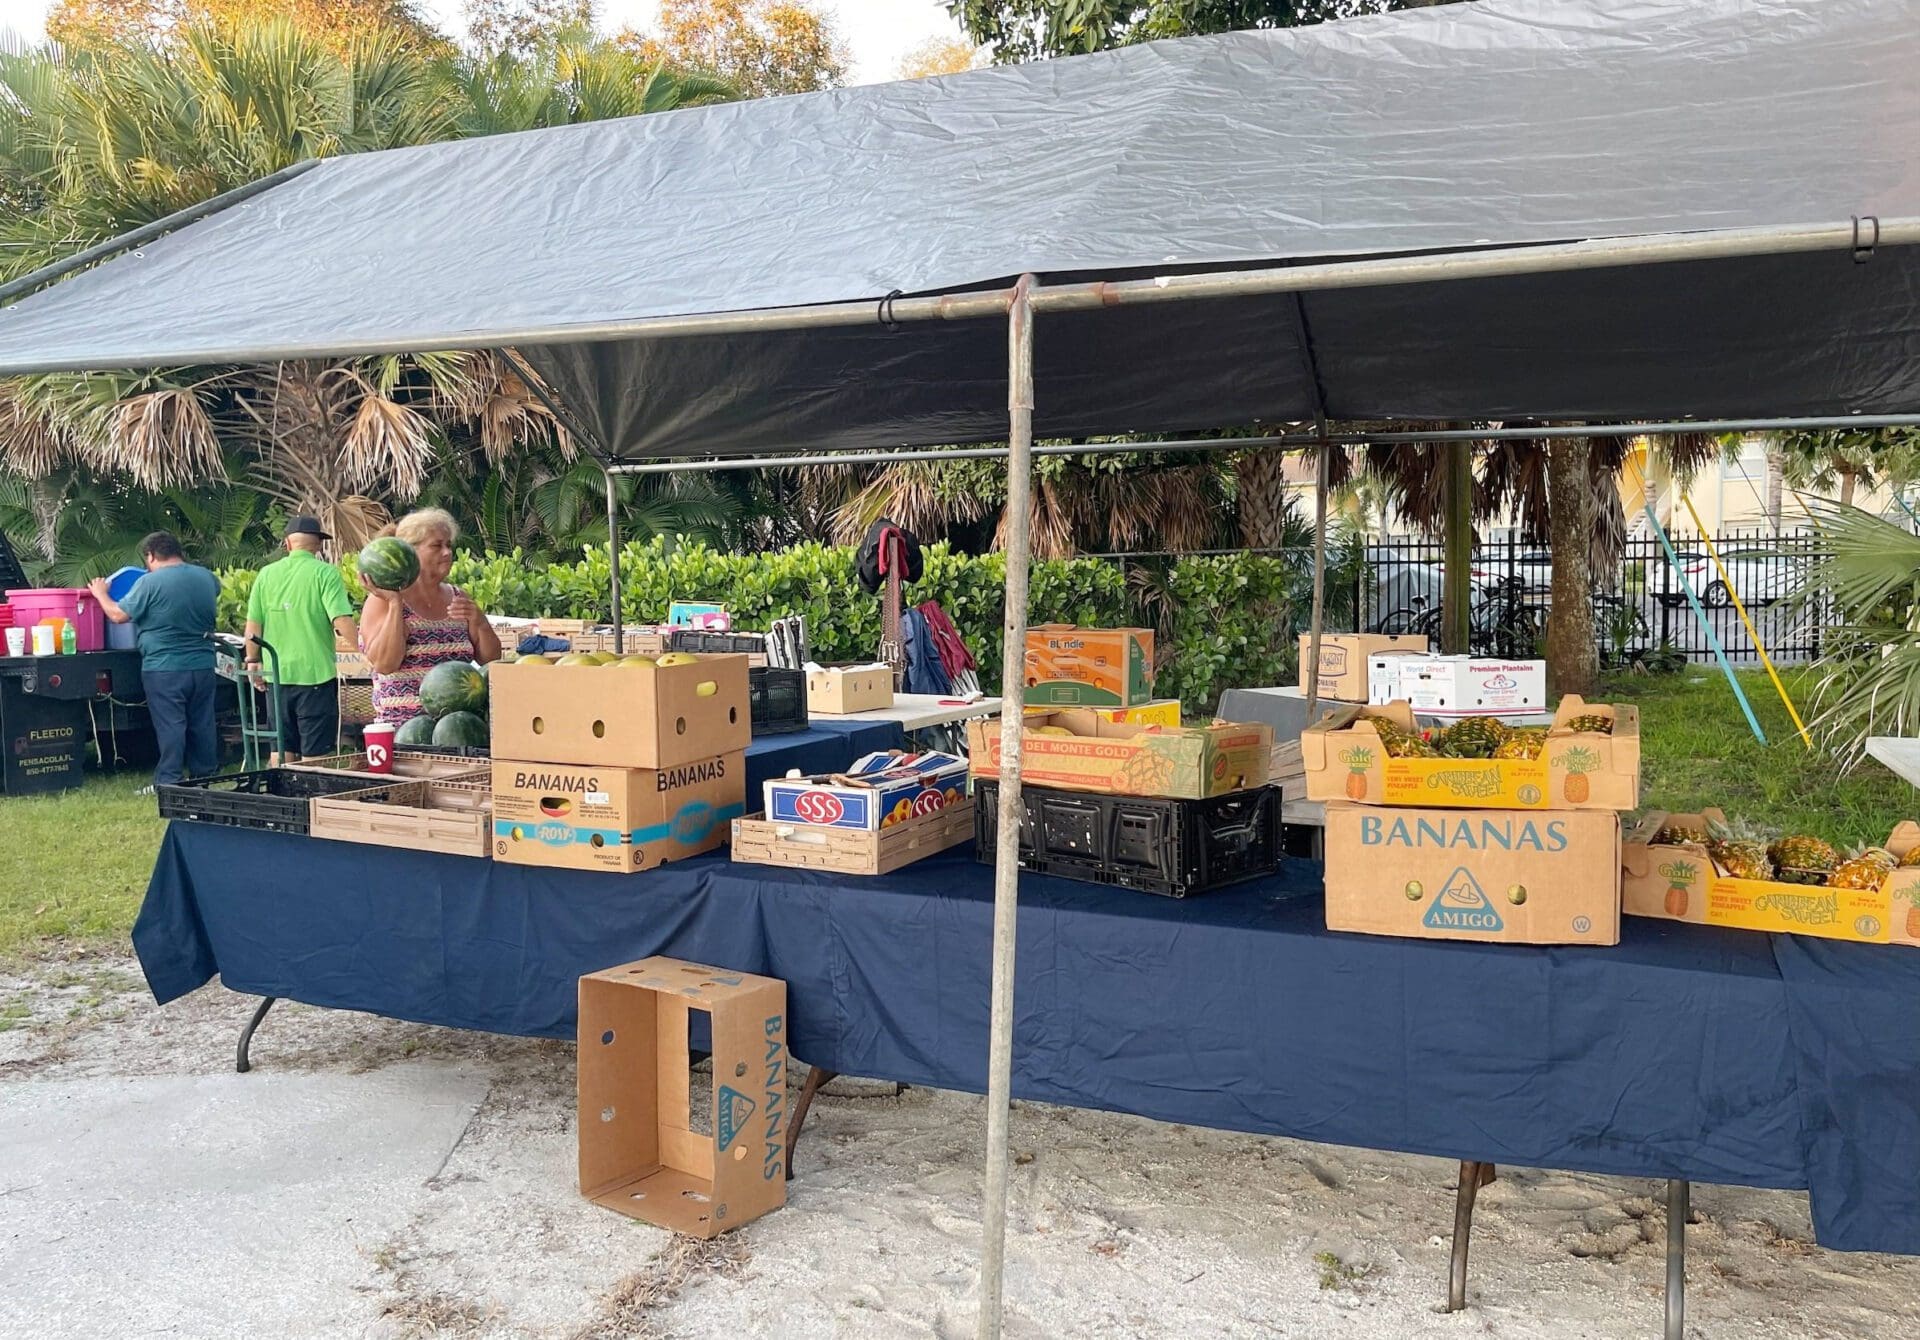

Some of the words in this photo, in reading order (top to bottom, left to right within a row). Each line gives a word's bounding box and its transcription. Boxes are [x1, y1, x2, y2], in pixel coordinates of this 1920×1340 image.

[30, 727, 73, 740] FLEETCO
[370, 749, 386, 764] K
[1026, 741, 1046, 751] DEL
[1051, 743, 1091, 755] MONTE
[1095, 746, 1130, 757] GOLD
[515, 772, 599, 792] BANANAS
[657, 759, 725, 792] BANANAS
[801, 795, 838, 820] SSS
[1361, 816, 1568, 852] BANANAS
[1429, 911, 1497, 928] AMIGO
[764, 1014, 783, 1180] BANANAS
[721, 1093, 729, 1147] AMIGO
